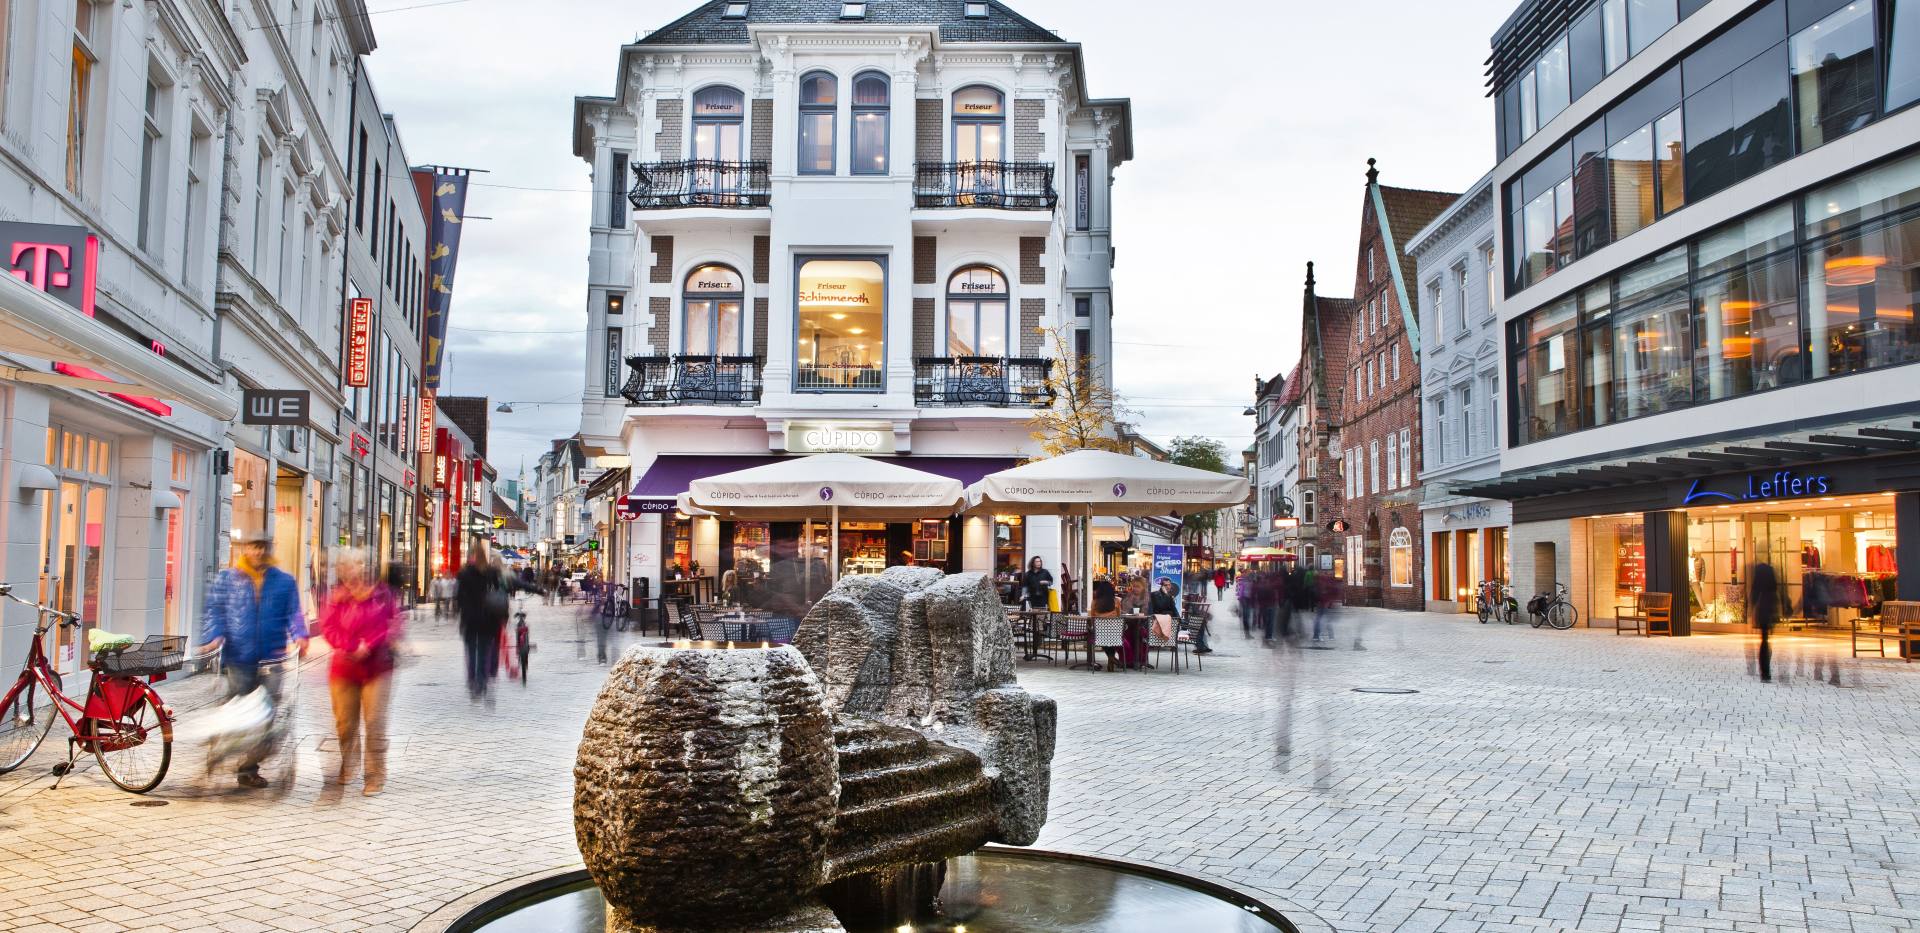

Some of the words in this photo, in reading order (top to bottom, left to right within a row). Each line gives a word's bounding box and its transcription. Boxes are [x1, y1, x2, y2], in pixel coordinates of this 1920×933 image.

[1079, 160, 1087, 220] FRISEUR
[799, 291, 870, 304] Schimmeroth
[961, 282, 995, 290] Friseur
[355, 303, 367, 332] THE
[353, 337, 366, 382] STING
[252, 397, 300, 417] WE
